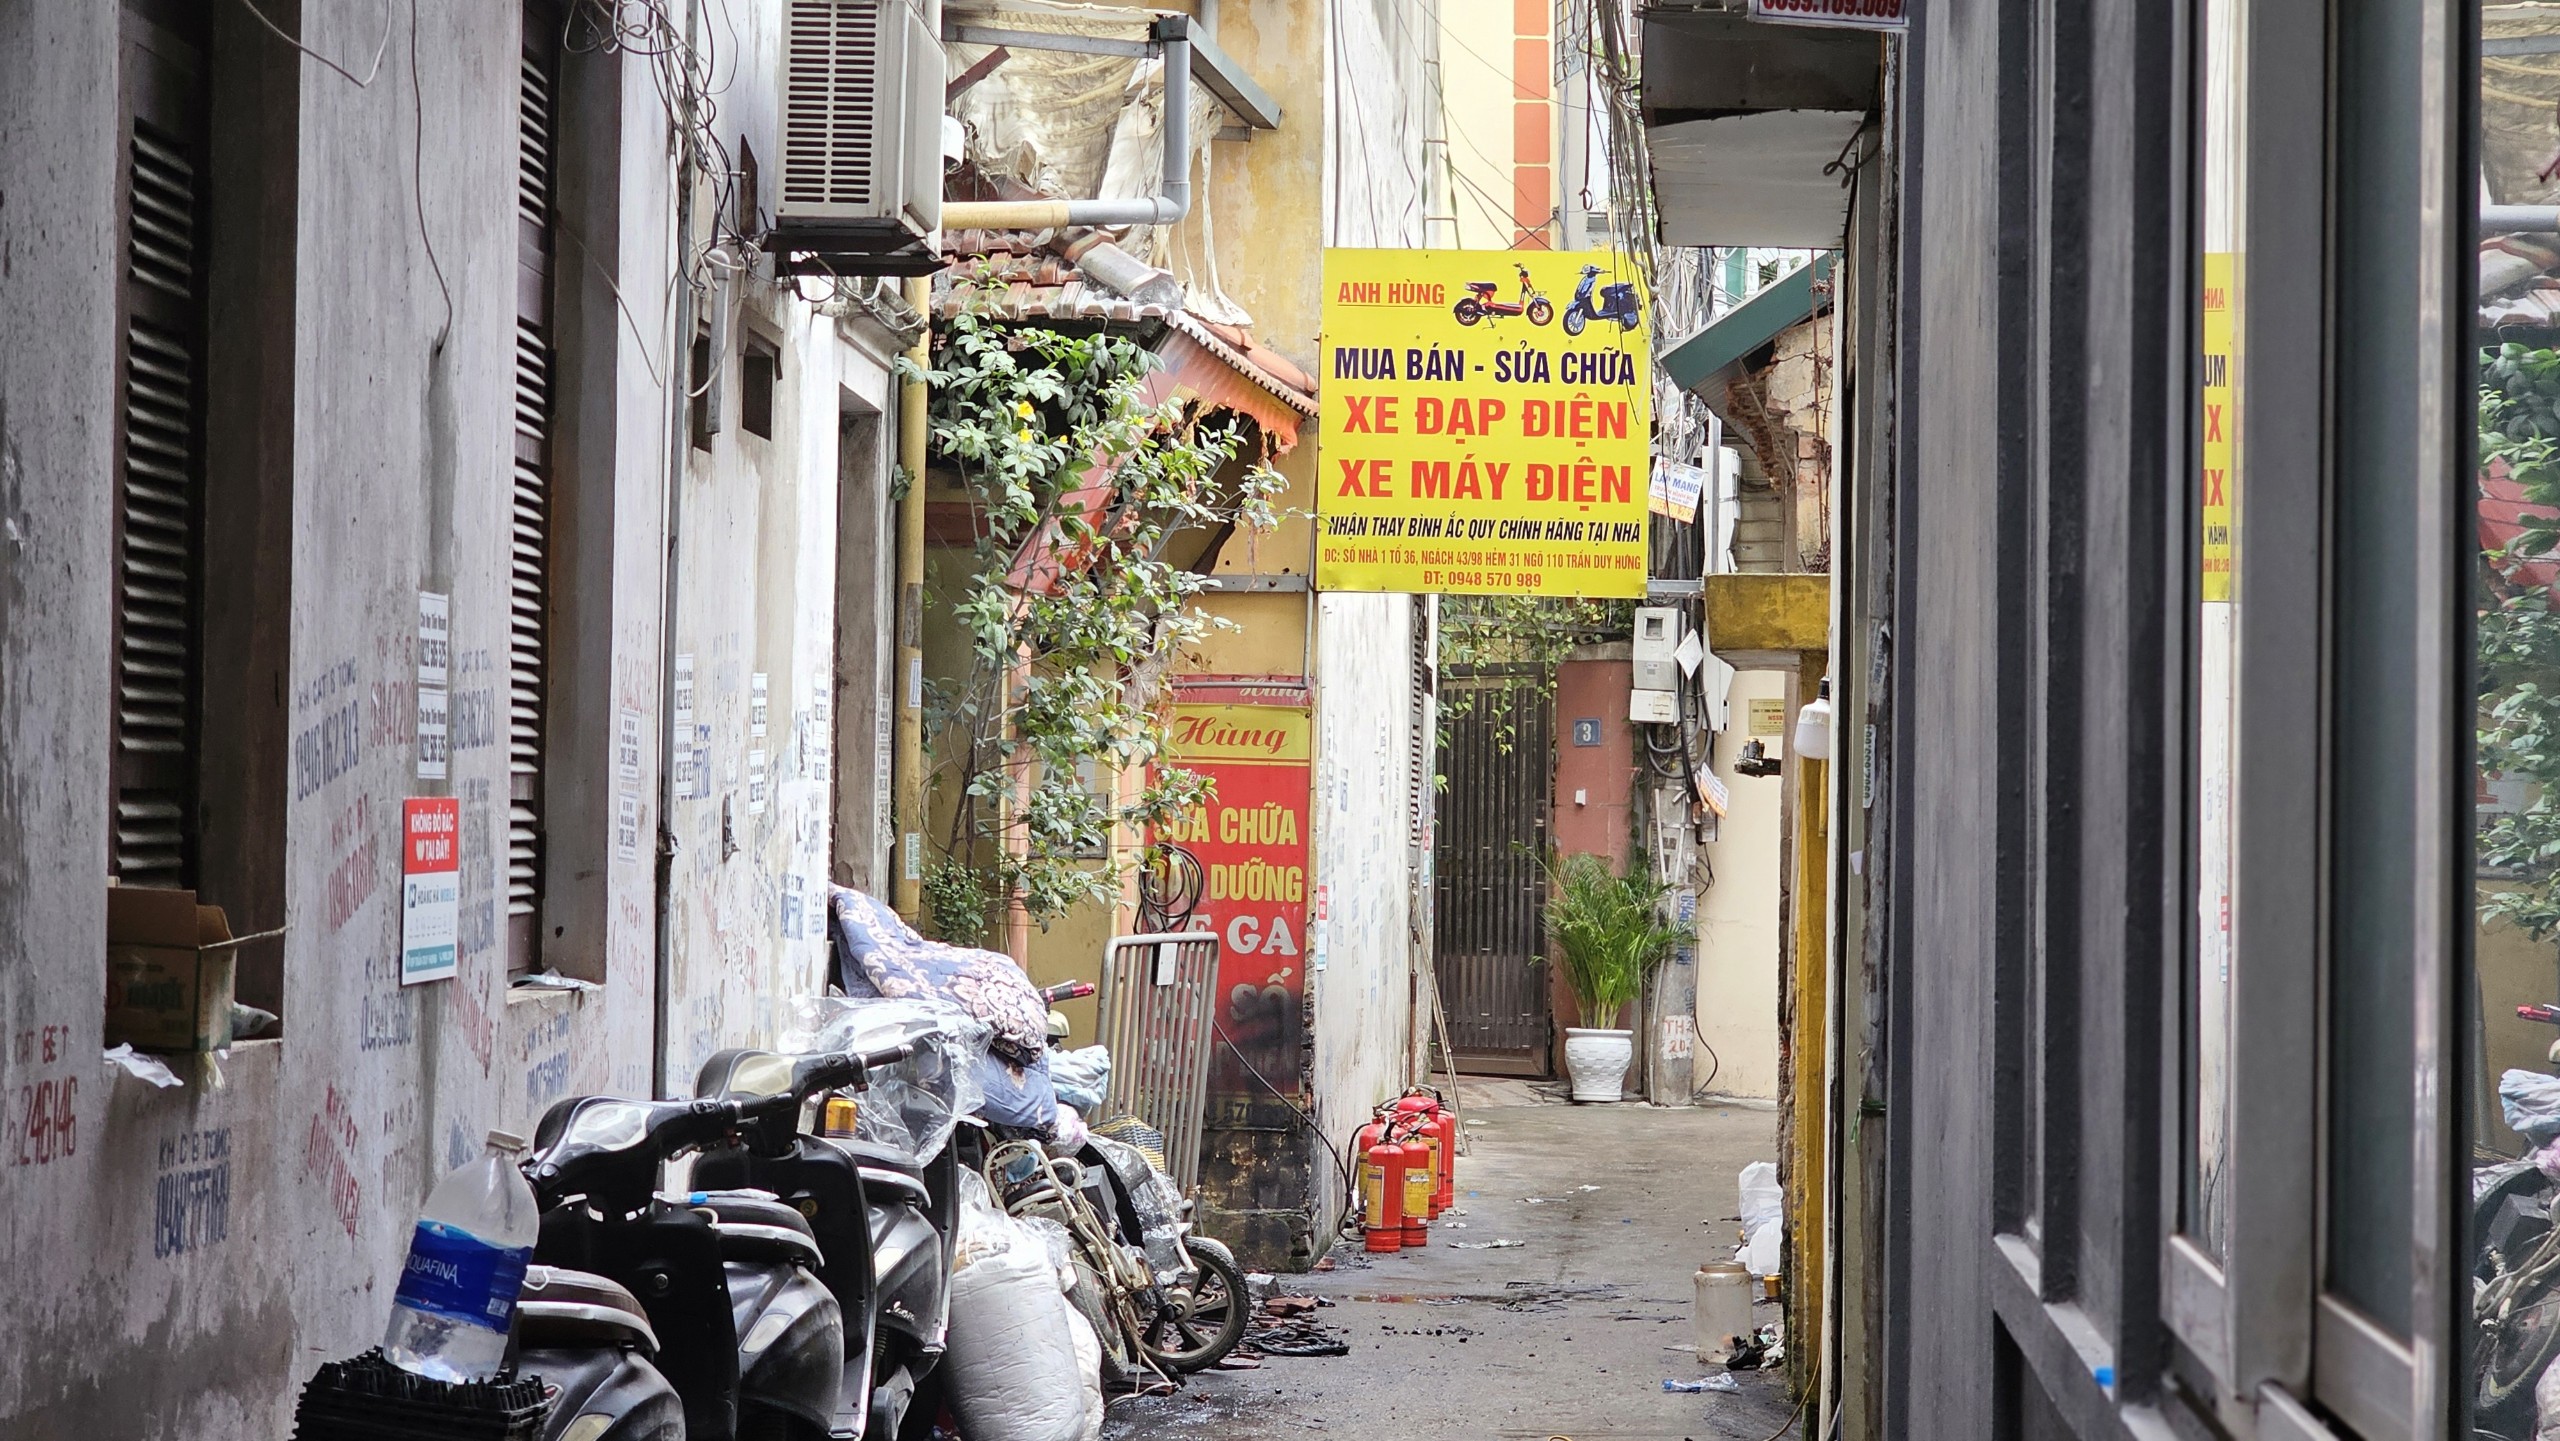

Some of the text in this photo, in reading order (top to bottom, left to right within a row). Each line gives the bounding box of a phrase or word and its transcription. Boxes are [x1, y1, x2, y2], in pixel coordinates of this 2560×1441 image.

[1338, 279, 1445, 304] ANH HÙNG
[1335, 347, 1396, 380] MUA
[1407, 342, 1464, 381] BÁN
[1495, 340, 1550, 383] SỬA
[1561, 347, 1635, 385] CHỮA
[1343, 392, 1627, 447] XE ĐẠP ĐIỆN
[1337, 460, 1392, 497] XE
[1411, 453, 1511, 500] MÁY
[1525, 456, 1631, 511] ĐIỆN
[1328, 511, 1640, 546] NHẬN THAY BÌNH ẮC QUY CHÍNH HÃNG TẠI NHÀ
[1325, 548, 1340, 563] ĐC:
[1343, 544, 1356, 564] SỐ
[1359, 546, 1378, 564] NHÀ
[1382, 550, 1386, 564] 1
[1404, 550, 1418, 566] 36,
[1422, 548, 1453, 565] NGÁCH
[1456, 551, 1482, 566] 43/98
[1510, 553, 1520, 567] 31
[1524, 551, 1543, 567] NGÕ
[1547, 554, 1563, 568] 110
[1594, 555, 1612, 569] DUY
[1615, 554, 1641, 570] HƯNG
[1424, 570, 1542, 587] ĐT: 0948 570 989
[1176, 715, 1288, 755] Hùng
[1583, 722, 1591, 741] 3
[1220, 802, 1298, 845] CHỮA
[1211, 857, 1303, 903] DƯỠNG
[1227, 916, 1298, 956] GA
